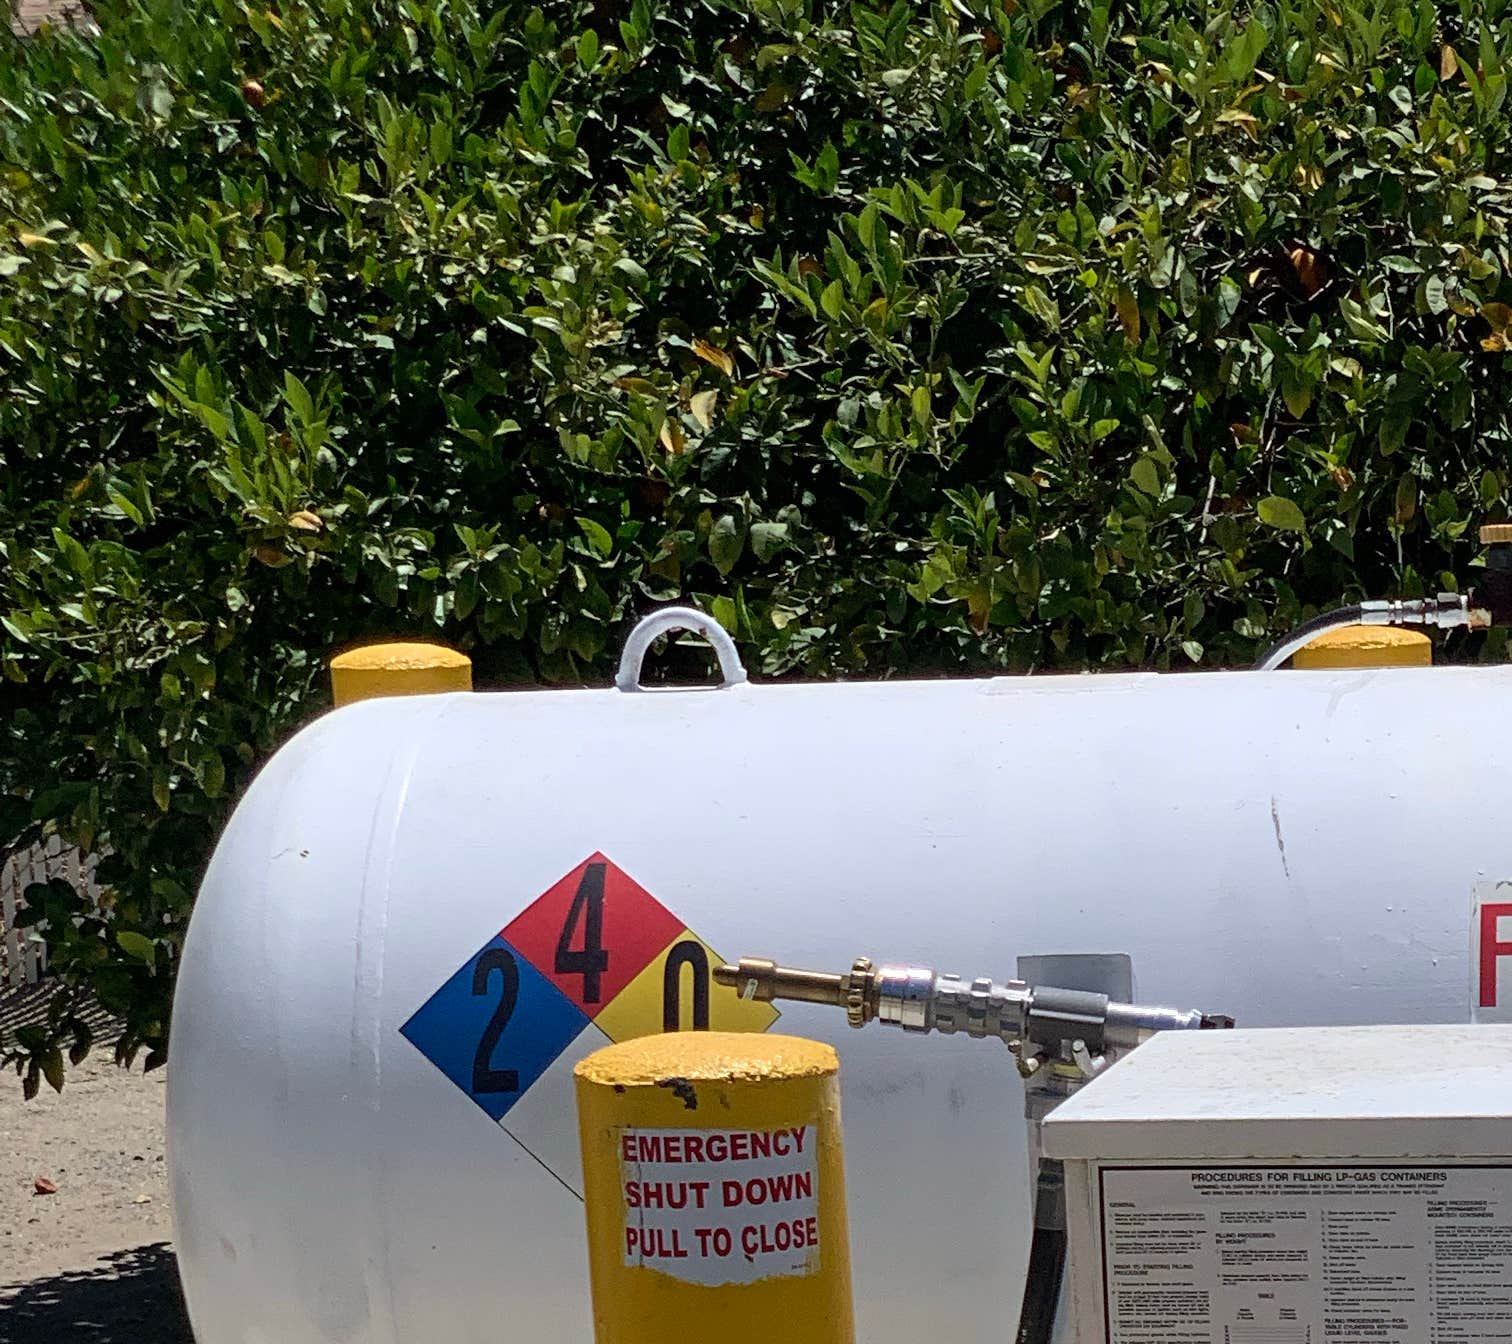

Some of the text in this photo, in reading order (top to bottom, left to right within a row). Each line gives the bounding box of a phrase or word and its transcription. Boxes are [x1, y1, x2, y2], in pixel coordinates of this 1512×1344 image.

[555, 863, 609, 1004] 4
[472, 948, 520, 1094] 2
[622, 1125, 806, 1164] EMERGENCY
[624, 1171, 811, 1209] SHUT DOWN
[1191, 1172, 1447, 1183] PROCEDURES FOR FILLING LP-GAS CONTAINERS
[625, 1216, 818, 1259] PULL TO CLOSE
